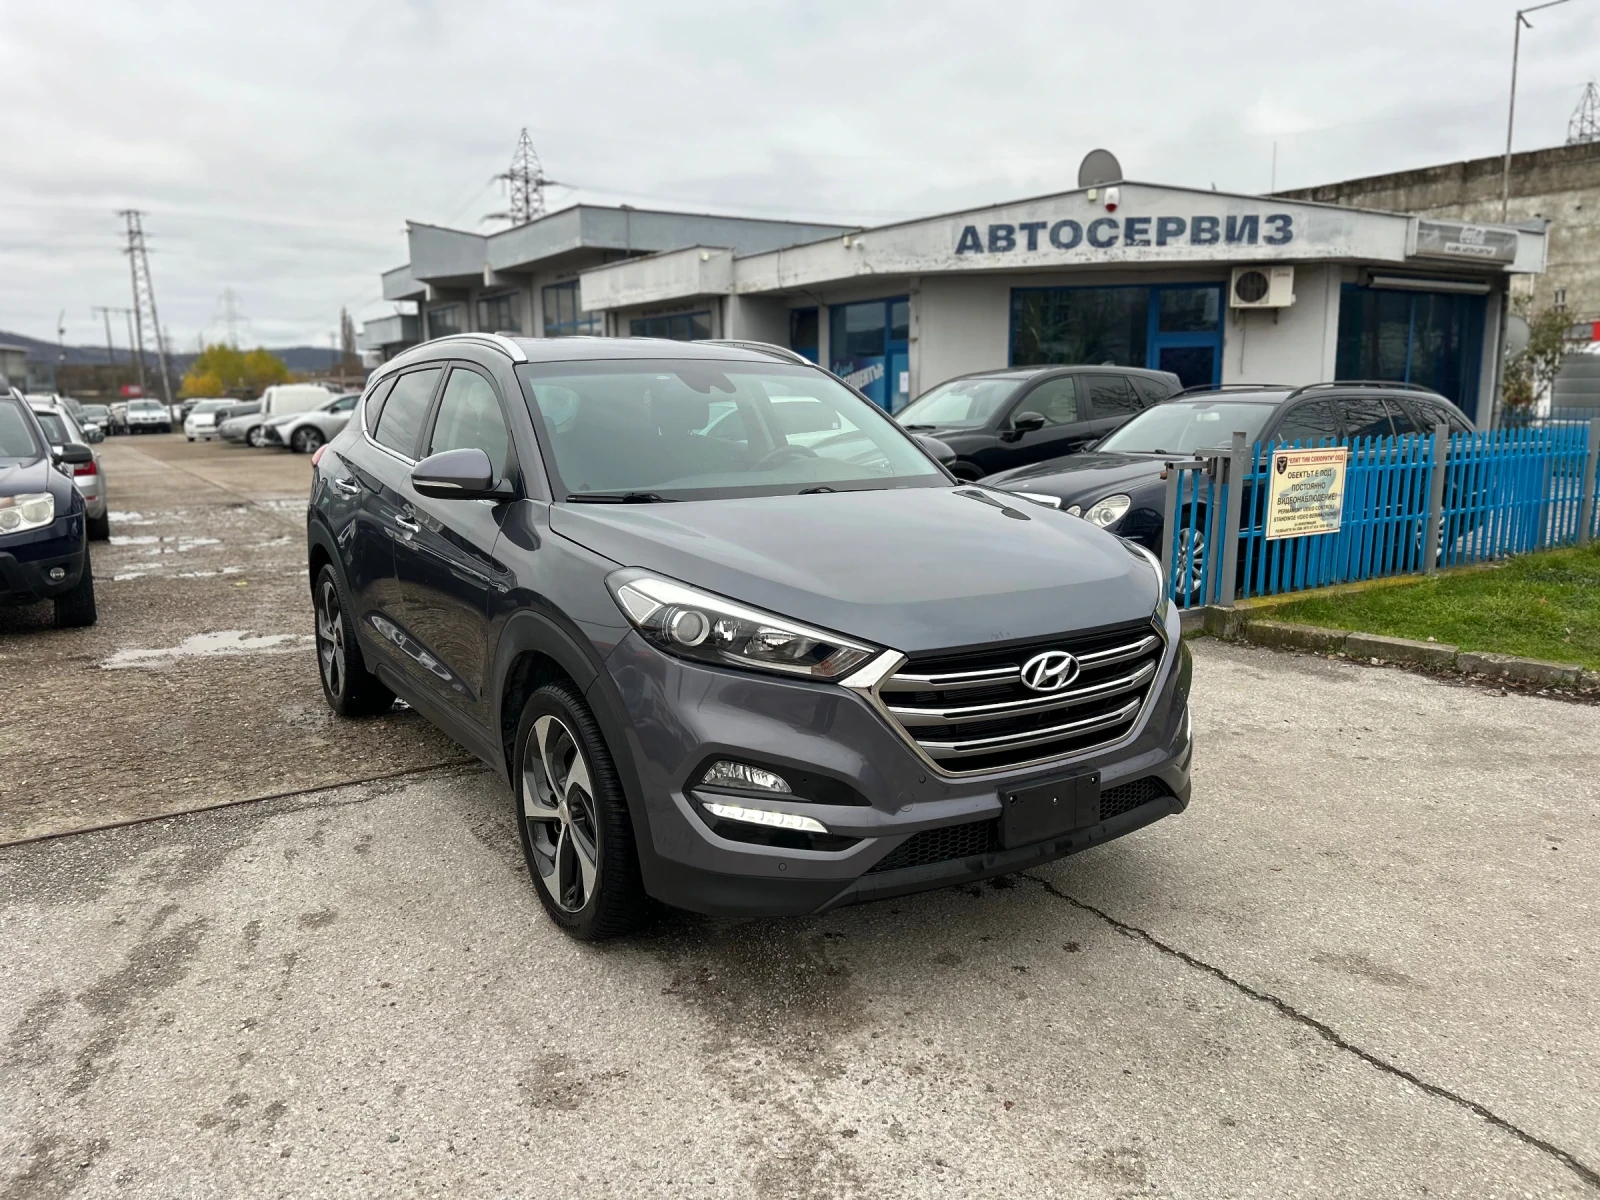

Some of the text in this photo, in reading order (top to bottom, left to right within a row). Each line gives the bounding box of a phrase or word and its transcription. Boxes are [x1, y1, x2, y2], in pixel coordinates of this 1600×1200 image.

[954, 213, 1294, 255] АВТОСЕРВИЗ
[1288, 471, 1314, 479] ОБЕКТЪТ
[1291, 482, 1326, 491] ПОСТОЯННО
[1277, 493, 1337, 506] ВИДЕОНАБЛЮДЕНИЕ!
